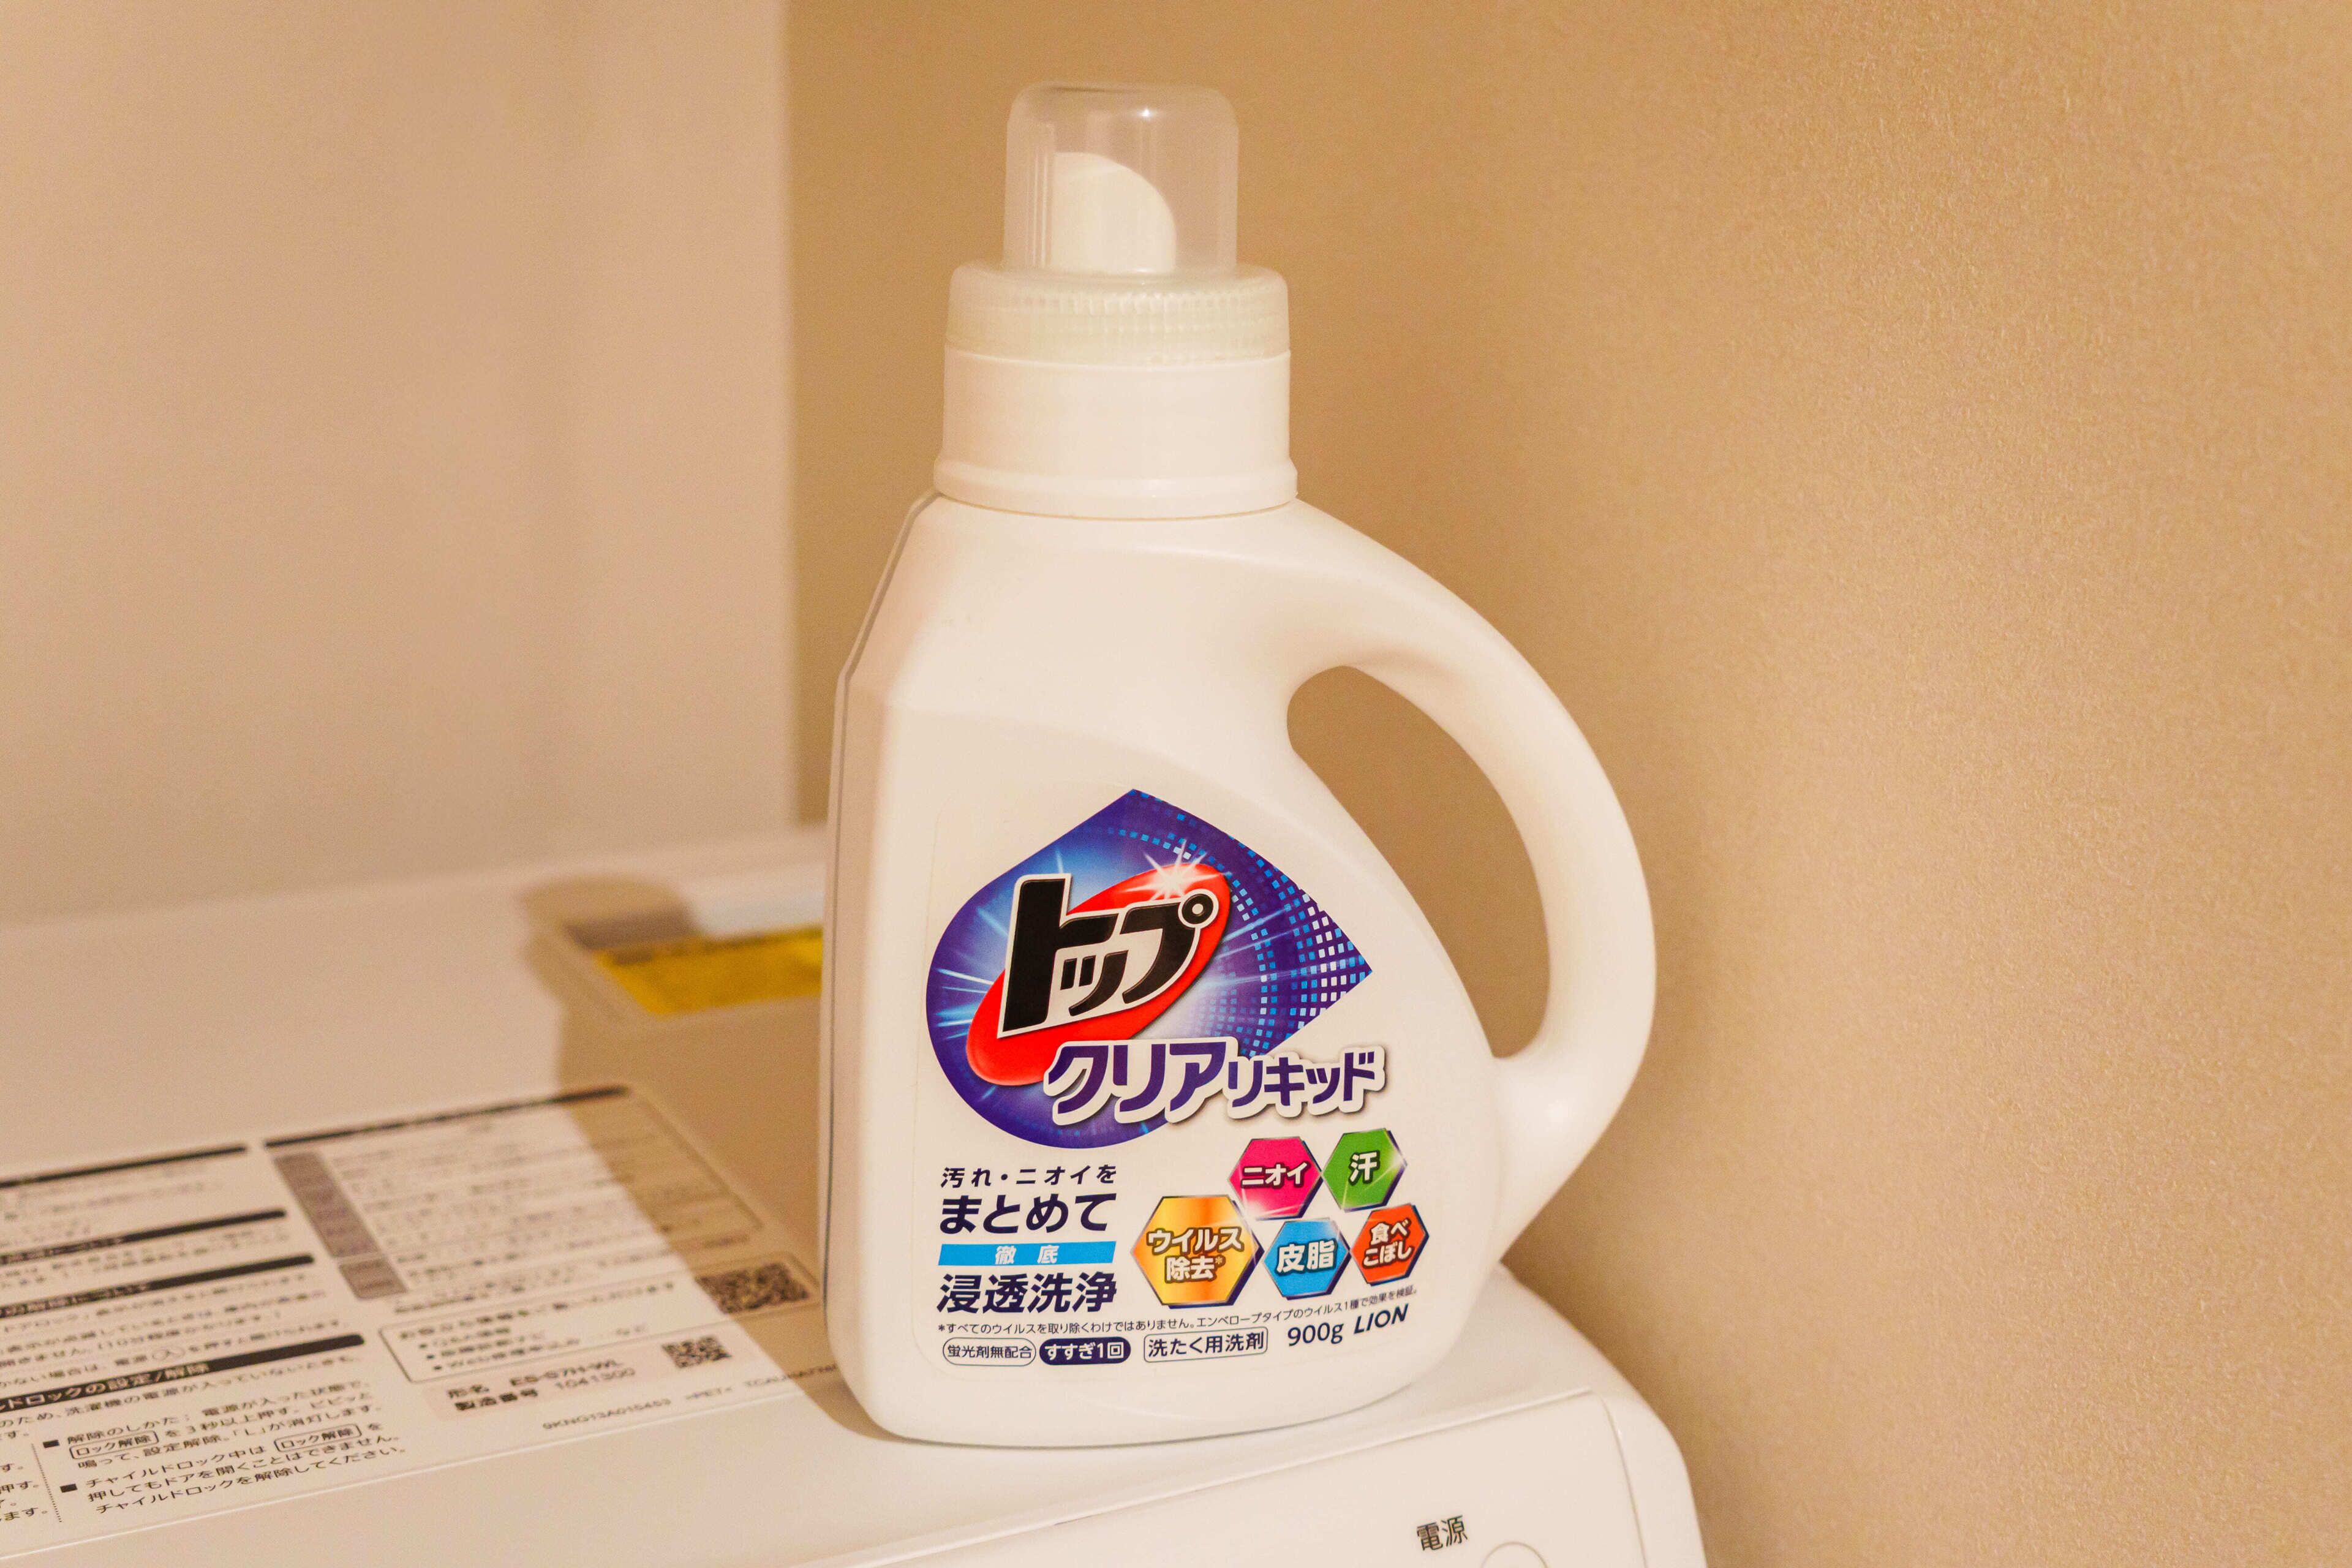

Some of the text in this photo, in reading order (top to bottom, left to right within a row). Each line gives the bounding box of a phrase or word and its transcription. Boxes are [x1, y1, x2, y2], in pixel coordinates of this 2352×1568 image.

[998, 874, 1218, 1038] トップ
[940, 1164, 1117, 1188] 汚れ・ニオイを
[1242, 1163, 1308, 1186] ニオイ
[1351, 1152, 1378, 1183] 汗
[940, 1193, 1117, 1235] まとめて
[1147, 1227, 1243, 1254] ウイルス
[1370, 1219, 1409, 1243] 食べ
[1276, 1241, 1336, 1273] 皮脂
[1363, 1244, 1412, 1268] こぼし
[937, 1272, 1117, 1314] 浸透洗浄
[1354, 1303, 1409, 1335] LION
[1148, 1331, 1264, 1358] 洗たく用洗剤
[1287, 1322, 1344, 1346] 900g
[948, 1345, 1033, 1359] 蛍光剤無配合
[1044, 1342, 1125, 1360] すすぎ1回
[0, 1363, 209, 1409] ドロックの設定/解除
[1416, 1515, 1468, 1551] 電源
